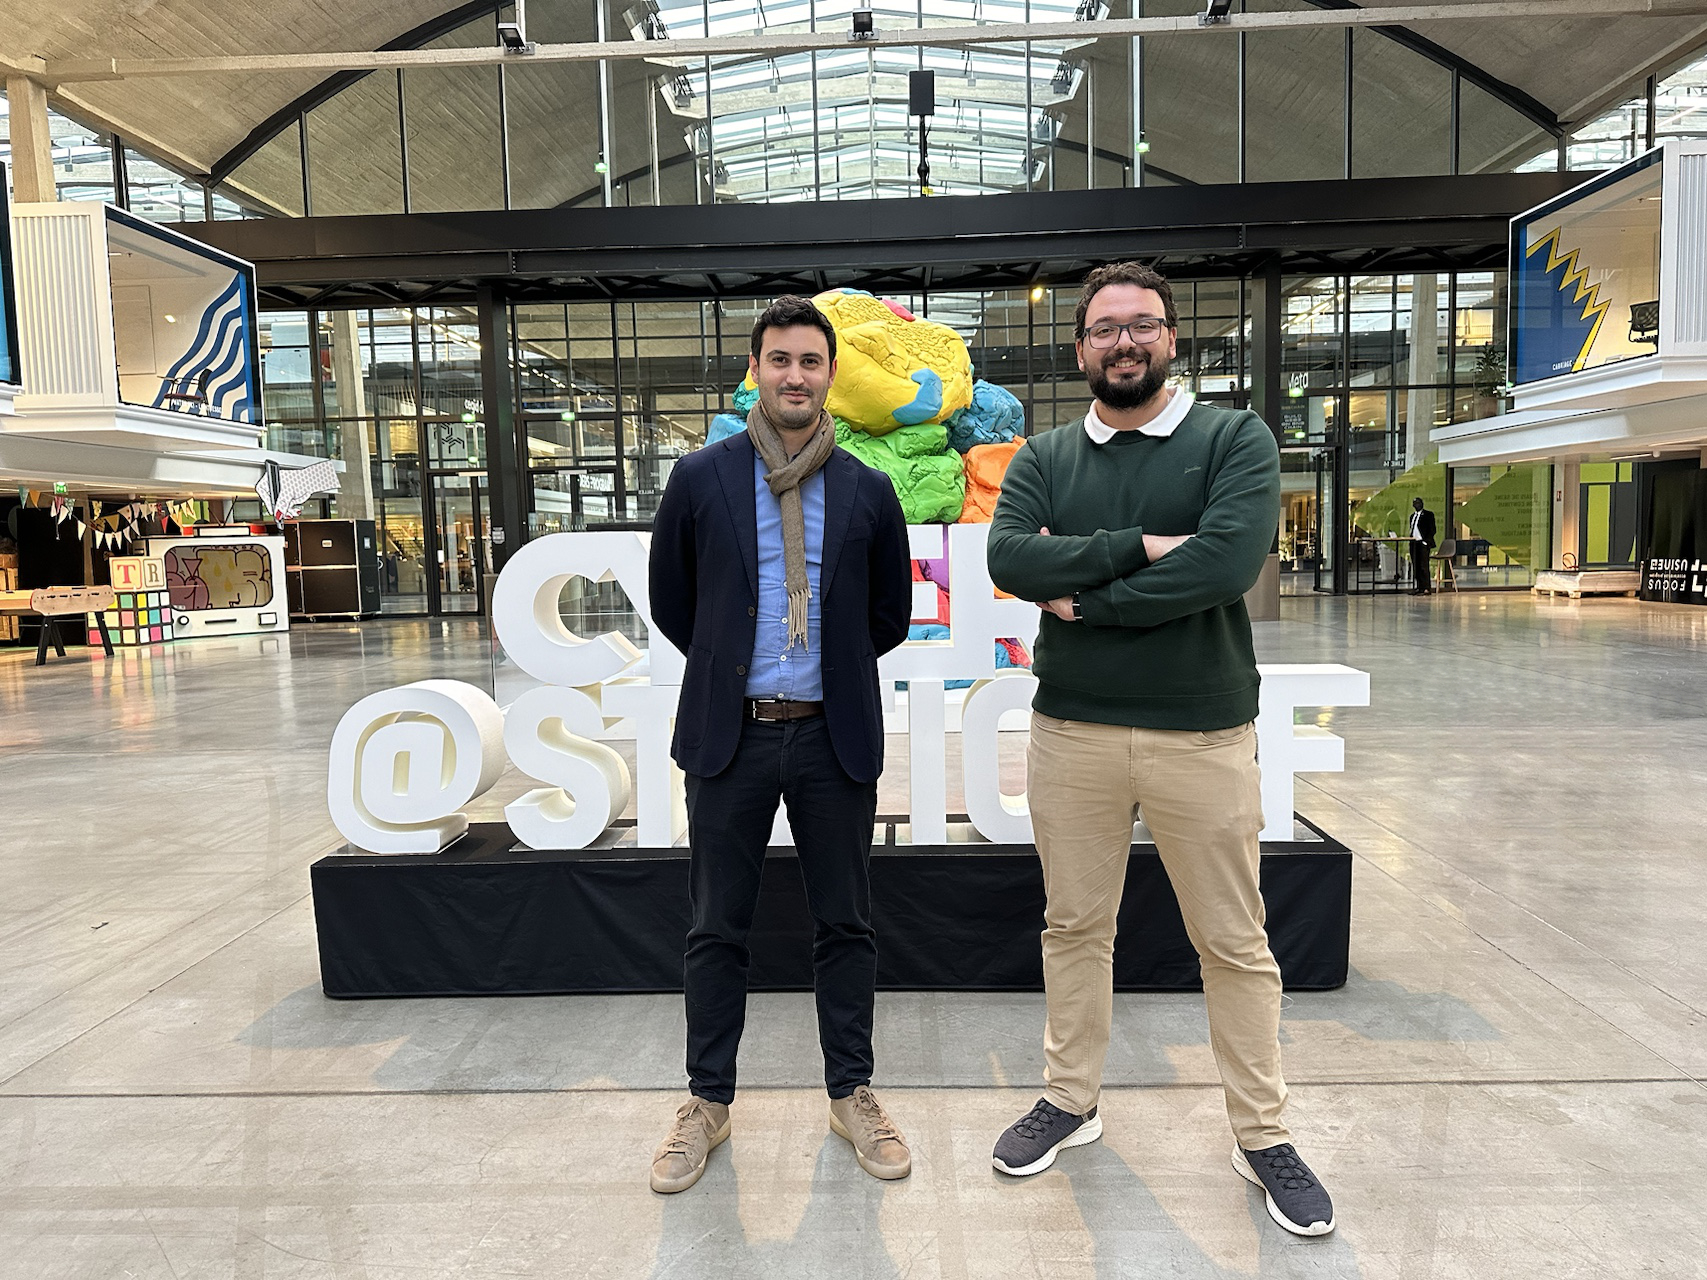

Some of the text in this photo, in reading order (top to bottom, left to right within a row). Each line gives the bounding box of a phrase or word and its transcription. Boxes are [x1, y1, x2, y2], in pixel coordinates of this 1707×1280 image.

[116, 563, 160, 584] T R
[1648, 578, 1686, 591] FOCUS
